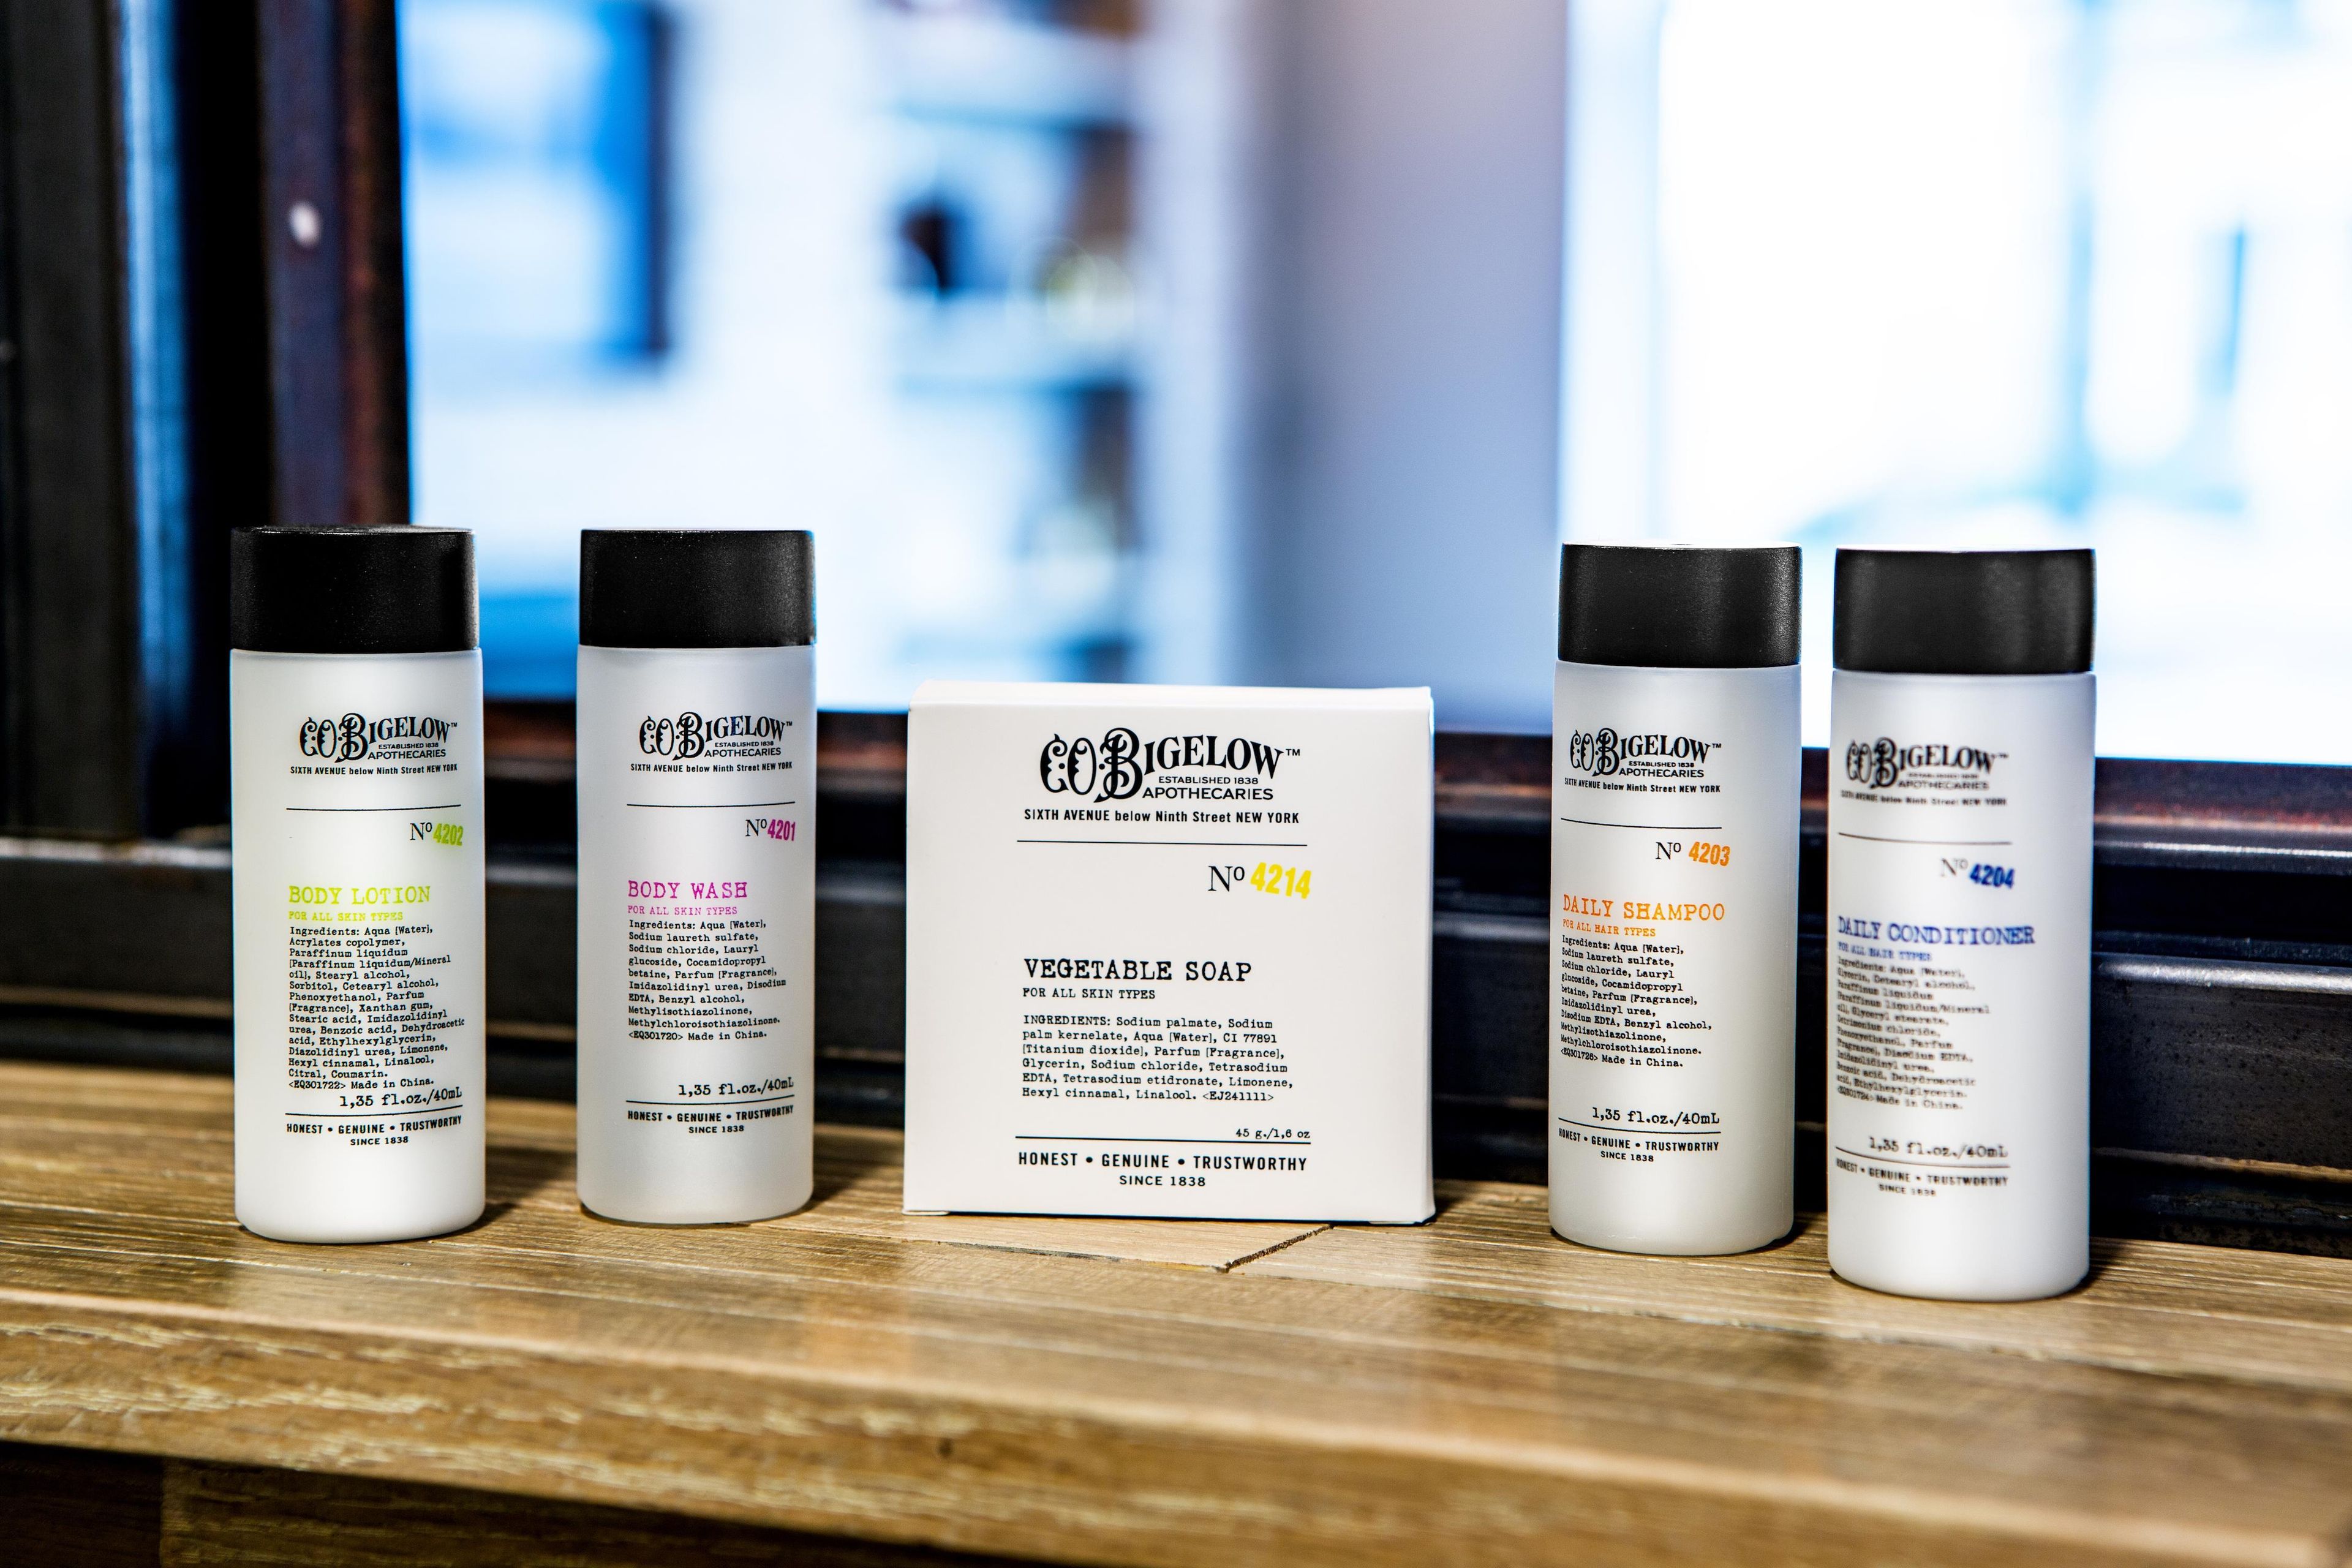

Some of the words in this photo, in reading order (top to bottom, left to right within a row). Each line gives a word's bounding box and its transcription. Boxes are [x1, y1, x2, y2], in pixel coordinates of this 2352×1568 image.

[368, 749, 447, 760] APOTHECARIES
[704, 747, 781, 757] APOTHECARIES
[401, 765, 425, 774] Street
[443, 763, 458, 772] YORK
[631, 763, 650, 772] SIXTH
[1618, 767, 1704, 778] APOTHECARIES
[1565, 777, 1577, 786] SIXTH
[1578, 780, 1600, 789] AVENUE
[1603, 782, 1624, 791] below
[1142, 787, 1273, 800] APOTHECARIES
[1025, 809, 1058, 820] SIXTH
[1064, 810, 1110, 821] AVENUE
[1115, 810, 1150, 821] below
[1156, 811, 1187, 822] Ninth
[1193, 811, 1231, 823] Street
[1236, 812, 1262, 823] NEW
[1267, 812, 1298, 823] YORK
[432, 823, 464, 847] 4202
[767, 819, 796, 842] 4201
[1689, 842, 1730, 867] 4203
[1250, 862, 1312, 900] 4214
[1969, 863, 2015, 889] 4204
[288, 885, 342, 905] BODY
[351, 886, 430, 905] LOTION
[628, 880, 680, 899] BODY
[690, 882, 747, 899] WASH
[628, 905, 645, 914] FOR
[650, 907, 669, 915] ALL
[707, 907, 737, 915] TYPES
[1563, 894, 1614, 918] DAILY
[1623, 902, 1725, 921] SHAMPOO
[288, 911, 307, 921] FOR
[311, 912, 333, 922] ALL
[337, 913, 366, 922] SKIN
[371, 911, 403, 922] TYPES
[290, 927, 359, 937] Ingredients:
[364, 927, 390, 937] Aqua
[629, 919, 695, 930] Ingredients:
[700, 921, 725, 931] Aqua
[1563, 919, 1574, 930] FOR
[1577, 922, 1591, 932] ALL
[1594, 924, 1619, 935] HAIR
[1624, 927, 1656, 938] TYPES
[1838, 916, 1882, 940] DAILY
[1888, 922, 2035, 945] CONDITIONER
[1562, 935, 1610, 950] Ingredients:
[1614, 942, 1638, 952] Aqua
[1024, 958, 1172, 980] VEGETABLE
[1186, 961, 1251, 982] SOAP
[1023, 987, 1046, 997] FOR
[1052, 988, 1076, 998] ALL
[1082, 989, 1113, 998] SKIN
[1118, 989, 1155, 999] TYPES
[1024, 1015, 1110, 1026] INGREDIENTS:
[1117, 1017, 1161, 1027] Sodium
[1166, 1017, 1221, 1029] palmate,
[1229, 1019, 1272, 1028] Sodium
[1023, 1030, 1052, 1040] palm
[1058, 1030, 1127, 1042] kernelate,
[1134, 1031, 1163, 1042] Aqua
[1223, 1033, 1237, 1042] CI
[1243, 1034, 1277, 1043] 77891
[1155, 1046, 1200, 1056] Parfum
[1022, 1058, 1085, 1070] Glycerin,
[1091, 1060, 1135, 1069] Sodium
[1141, 1061, 1202, 1072] chloride,
[1209, 1062, 1287, 1072] Tetrasodium
[1023, 1072, 1057, 1084] EDTA,
[1063, 1074, 1141, 1084] Tetrasodium
[1147, 1076, 1223, 1087] etidronate,
[1229, 1077, 1292, 1088] Limonene,
[679, 1085, 711, 1098] 1,35
[1022, 1087, 1059, 1099] Hexyl
[1065, 1088, 1129, 1099] cinnamal,
[1136, 1090, 1196, 1099] Linalool.
[339, 1095, 374, 1109] 1,35
[627, 1110, 663, 1121] HONEST
[677, 1112, 722, 1122] GENUINE
[736, 1105, 793, 1120] TRUSTWORTHY
[1593, 1107, 1621, 1121] 1,35
[287, 1123, 323, 1134] HONEST
[338, 1124, 385, 1134] GENUINE
[400, 1115, 461, 1131] TRUSTWORTHY
[1236, 1128, 1250, 1137] 45
[385, 1136, 409, 1144] 1838
[1559, 1128, 1581, 1142] HONEST
[1591, 1136, 1630, 1149] GENUINE
[1645, 1141, 1719, 1152] TRUSTWORTHY
[1019, 1152, 1077, 1166] HONEST
[1102, 1153, 1169, 1168] GENUINE
[1193, 1156, 1306, 1170] TRUSTWORTHY
[1600, 1150, 1626, 1160] SINCE
[1120, 1175, 1163, 1186] SINCE
[1171, 1176, 1205, 1186] 1838
[1868, 1167, 1909, 1182] GENUINE
[1928, 1175, 2008, 1186] TRUSTWORTHY
